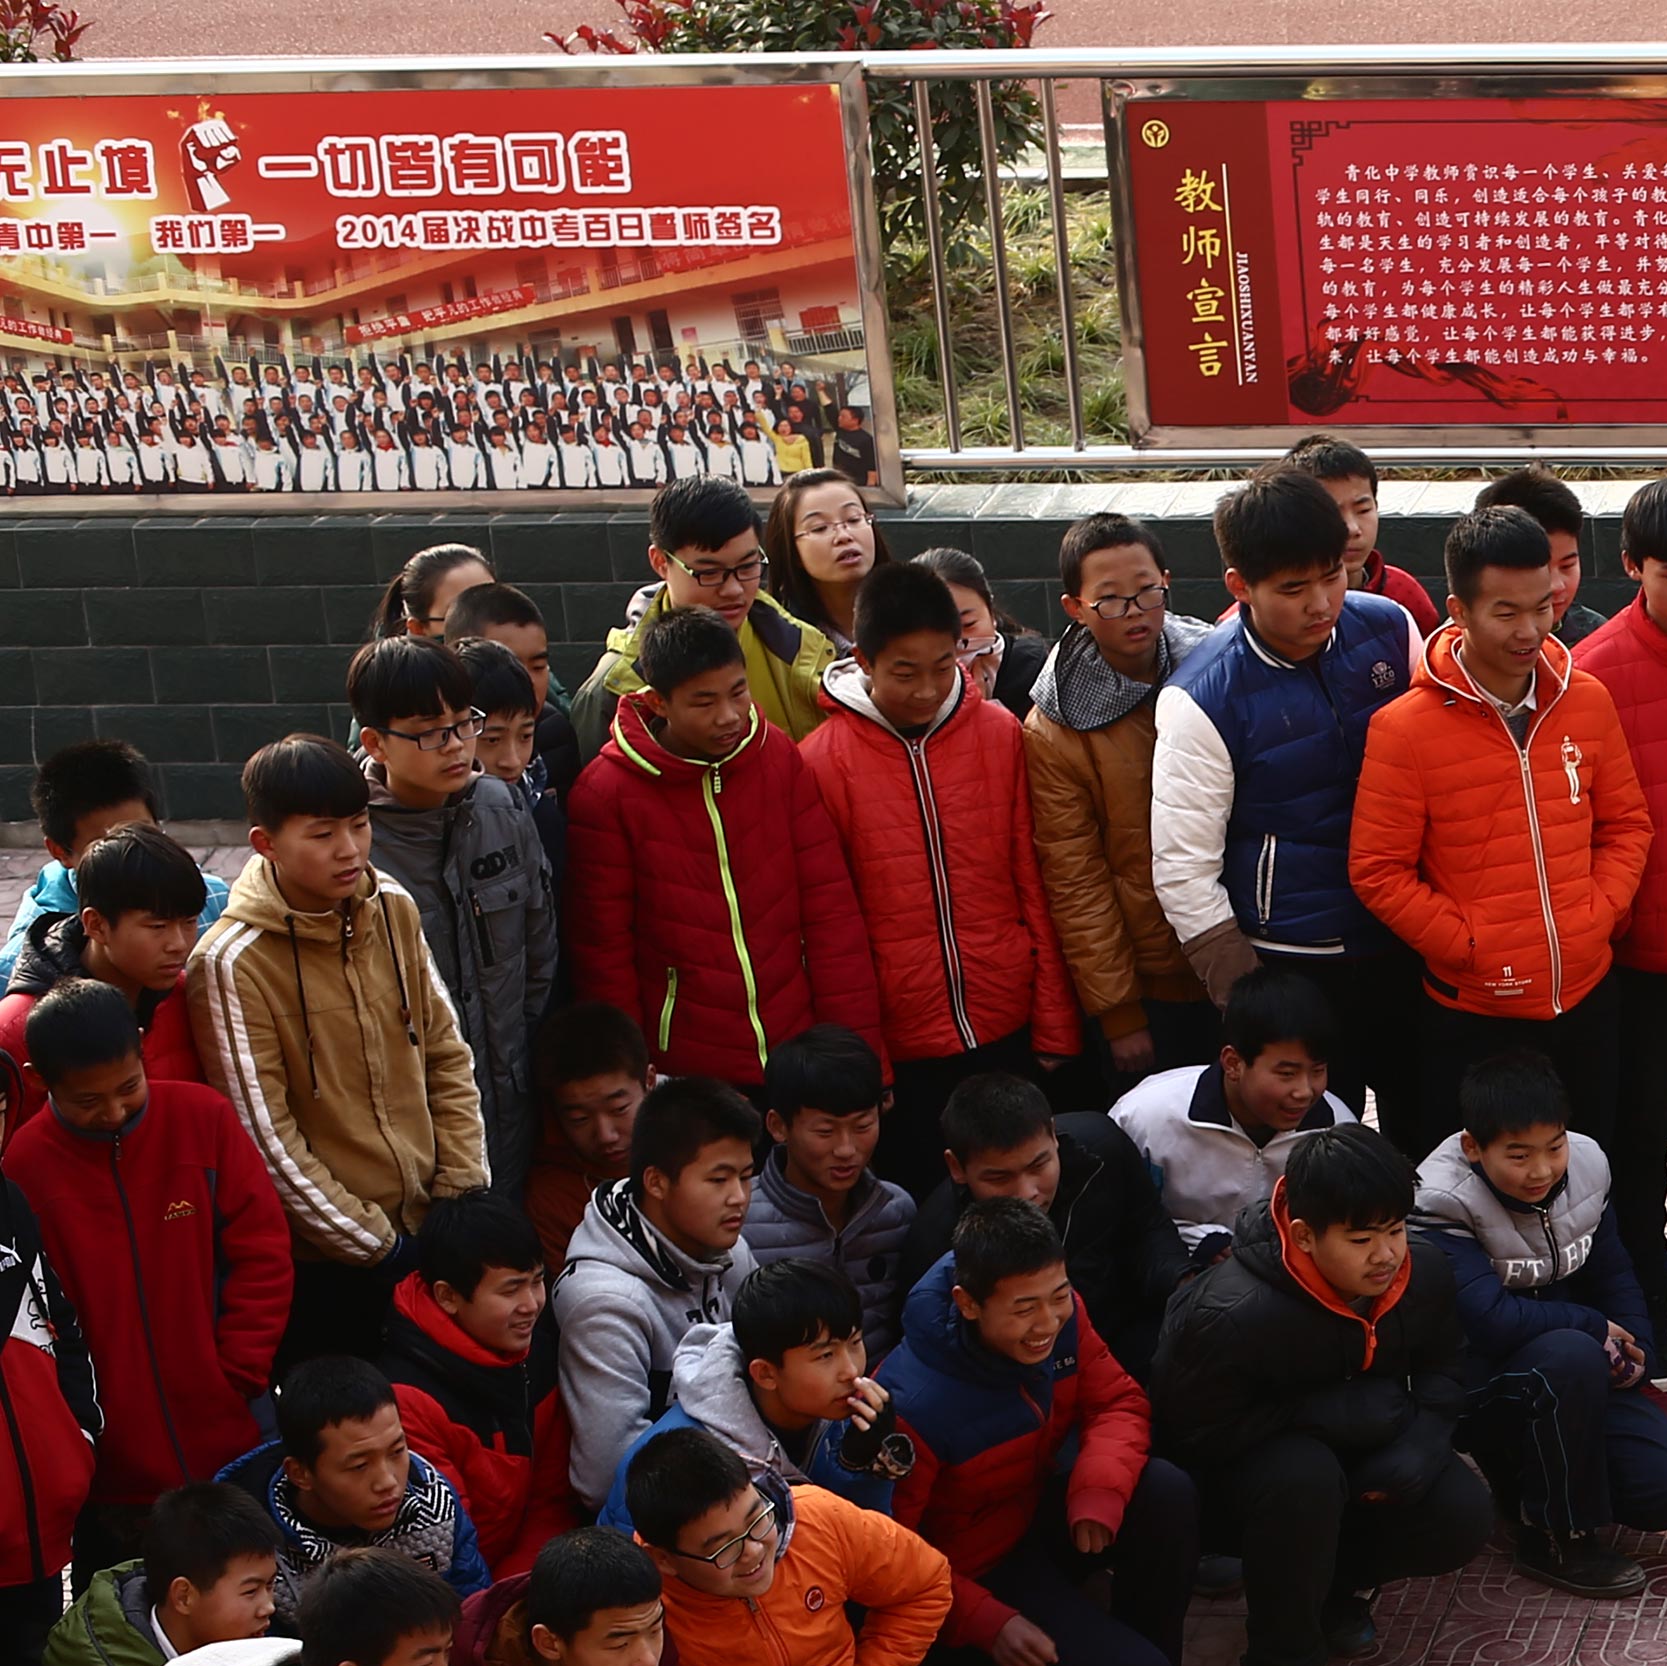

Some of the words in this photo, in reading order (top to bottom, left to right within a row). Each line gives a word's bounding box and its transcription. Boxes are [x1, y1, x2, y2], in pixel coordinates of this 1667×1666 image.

[258, 131, 631, 196] 一切皆有可能
[151, 213, 286, 255] 我们第一
[336, 205, 782, 248] 2014届决战中考百日誓师签名
[1174, 168, 1229, 377] 教师宣言
[1236, 251, 1258, 383] JIAOSHIXUANYAN
[1329, 347, 1648, 365] 来，让每个学生都能创造成功与幸福。
